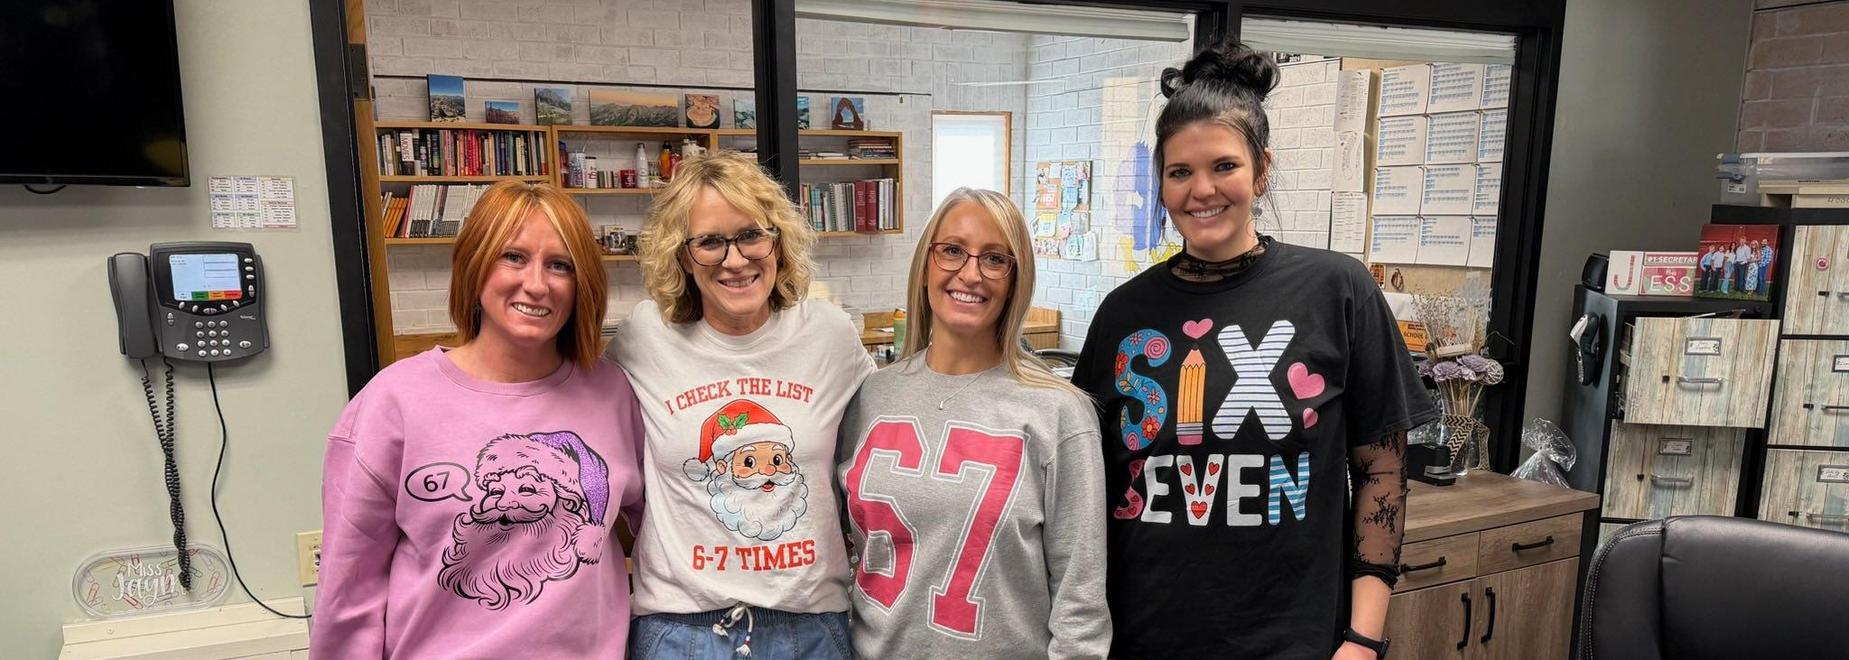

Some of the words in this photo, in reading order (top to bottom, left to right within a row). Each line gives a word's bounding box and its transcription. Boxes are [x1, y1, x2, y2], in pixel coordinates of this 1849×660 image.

[401, 137, 410, 160] MOVIES
[664, 400, 675, 416] I
[676, 380, 733, 411] CHECK
[736, 378, 772, 396] THE
[775, 380, 814, 403] LIST
[423, 471, 450, 493] 67
[1113, 451, 1311, 527] SEVEN
[845, 415, 1031, 642] 67
[692, 544, 729, 572] 6-7
[735, 539, 816, 572] TIMES
